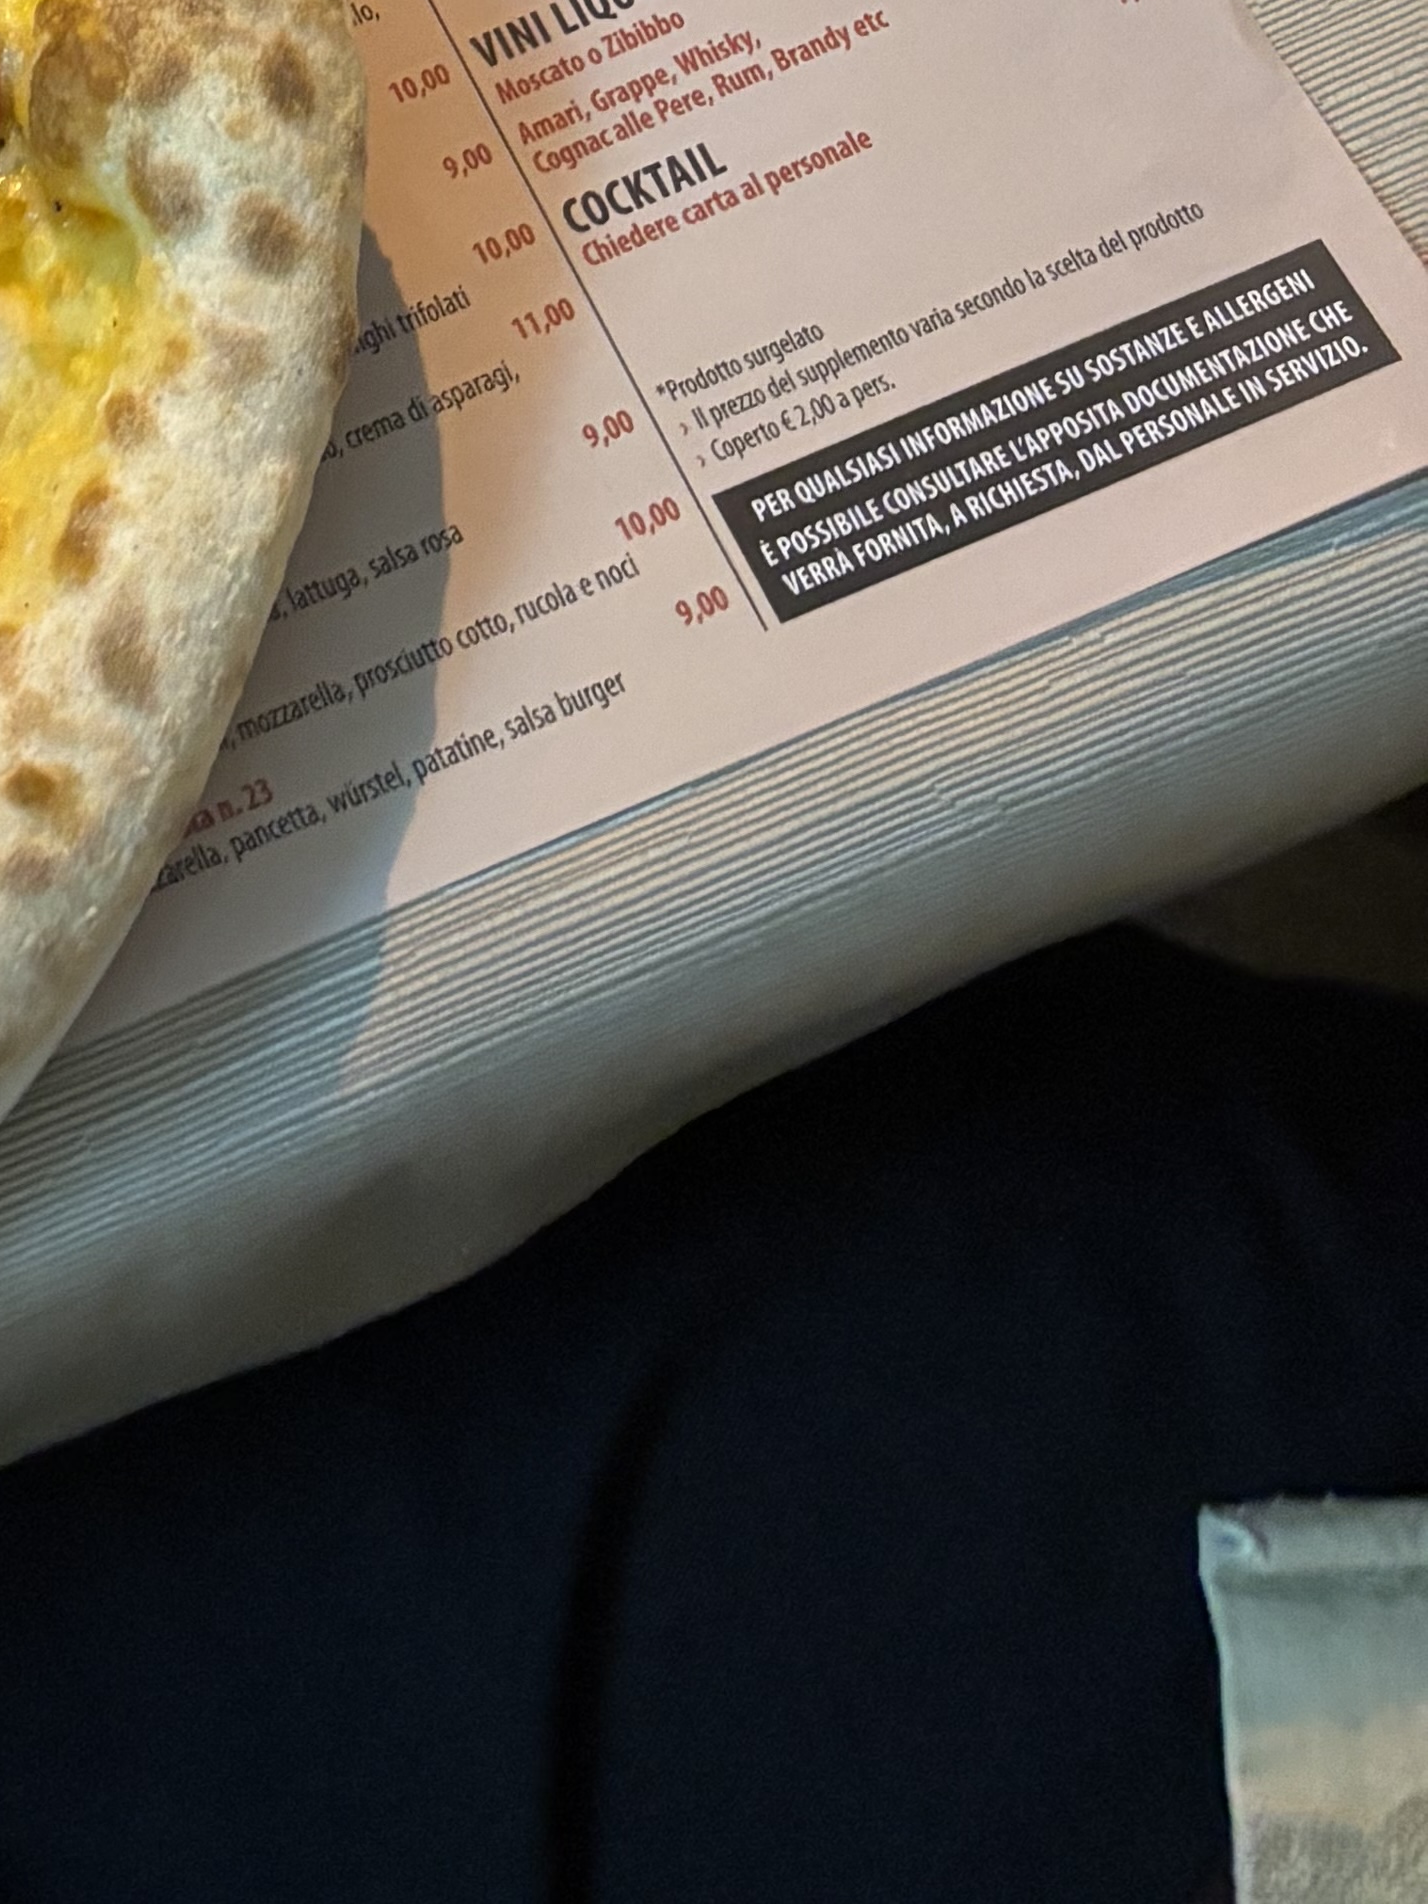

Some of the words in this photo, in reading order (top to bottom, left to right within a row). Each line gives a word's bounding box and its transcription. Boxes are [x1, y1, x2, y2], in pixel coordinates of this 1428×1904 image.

[468, 10, 553, 68] VINI
[562, 141, 729, 234] COCKTAIL
[581, 213, 682, 266] Chiedere
[681, 188, 742, 225] carta
[739, 170, 766, 201] al
[763, 129, 874, 196] personale
[709, 420, 782, 462] Coperto
[780, 408, 799, 432] €
[792, 392, 837, 427] 2,00
[835, 391, 852, 409] a
[849, 373, 897, 409] pers.
[750, 488, 796, 522] PER
[794, 441, 902, 504] QUALSIASI
[899, 377, 1058, 460] INFORMAZIONE
[1054, 364, 1086, 395] SU
[1083, 322, 1190, 382] SOSTANZE
[1184, 315, 1205, 339] E
[1202, 268, 1316, 333] ALLERGENI
[759, 539, 780, 567] È
[775, 498, 885, 560] POSSIBILE
[882, 444, 1012, 515] CONSULTARE
[1121, 318, 1312, 414] DOCUMENTAZIONE
[1308, 299, 1353, 333] CHE
[614, 496, 682, 541] 10,00
[781, 547, 855, 595] VERRÀ
[851, 512, 951, 567] FORNITA,
[949, 502, 969, 528] A
[964, 458, 1081, 520] RICHIESTA,
[1076, 438, 1124, 472] DAL
[1118, 386, 1242, 455] PERSONALE
[1237, 375, 1268, 403] IN
[1264, 335, 1369, 393] SERVIZIO.
[236, 680, 353, 740] mozzarella,
[353, 636, 454, 699] prosciutto
[455, 612, 516, 649] cotto,
[513, 581, 580, 625] rucola
[578, 576, 596, 598] e
[593, 550, 641, 591] noci
[674, 584, 730, 627] 9,00
